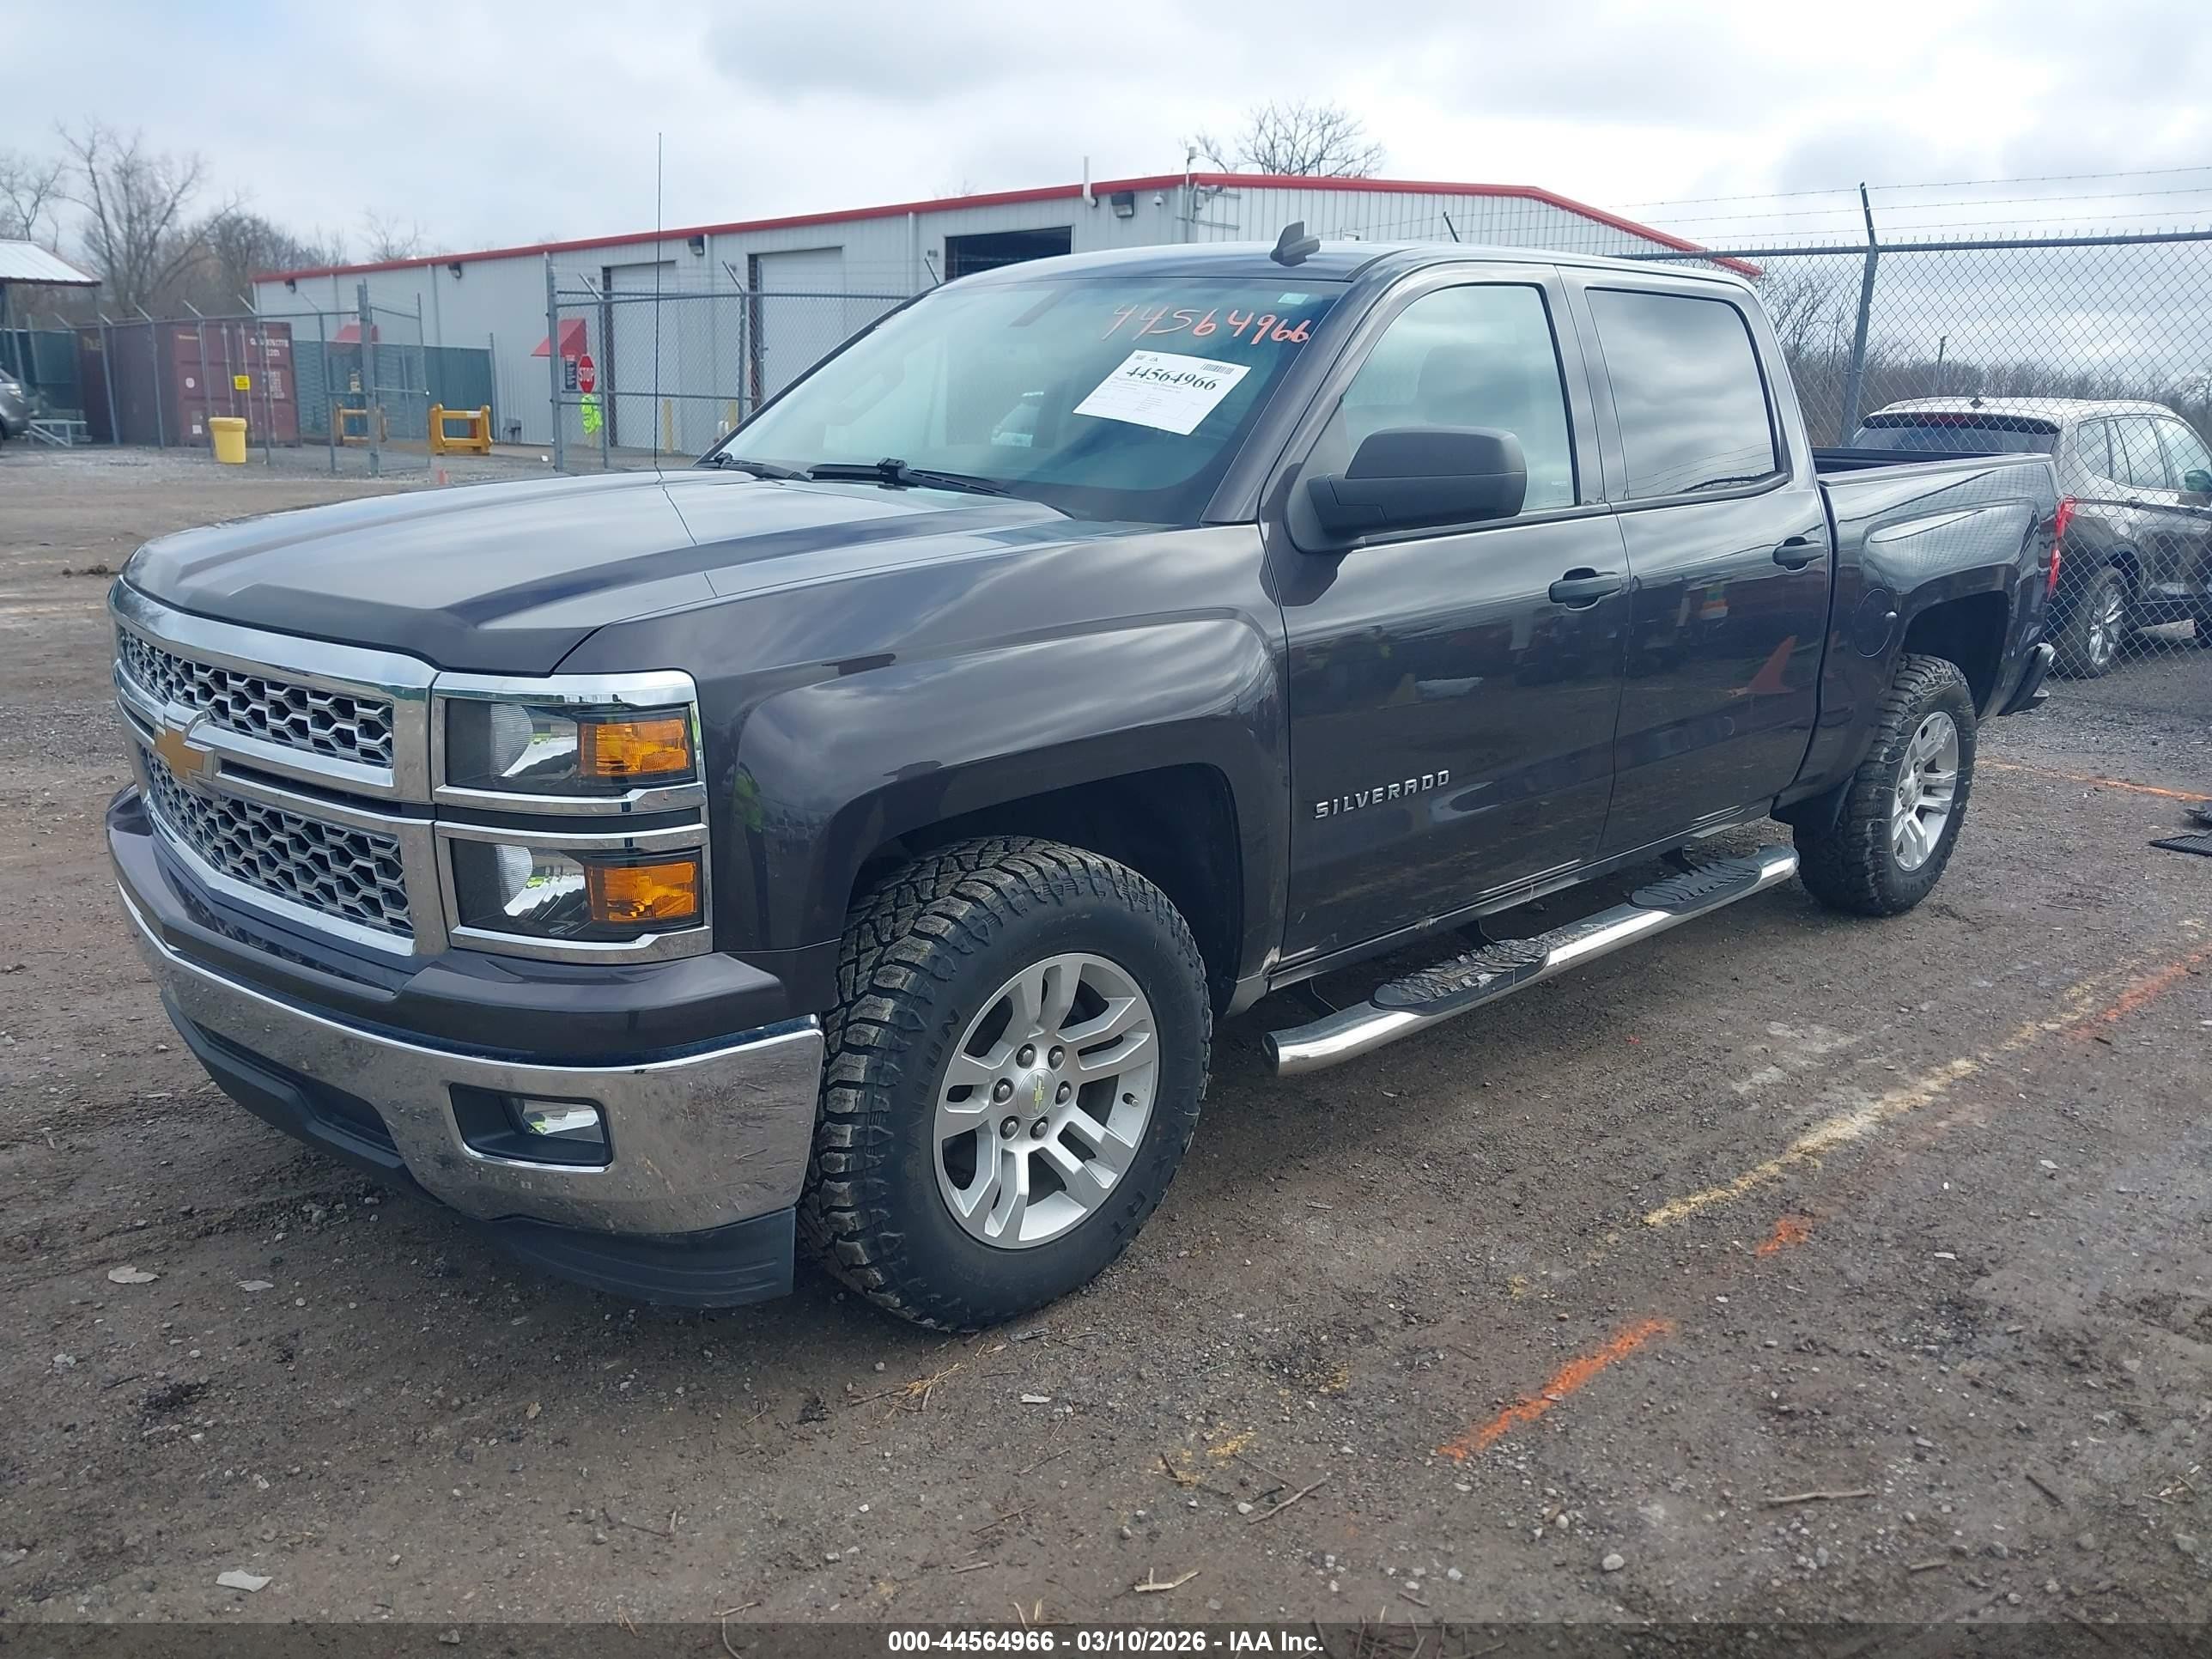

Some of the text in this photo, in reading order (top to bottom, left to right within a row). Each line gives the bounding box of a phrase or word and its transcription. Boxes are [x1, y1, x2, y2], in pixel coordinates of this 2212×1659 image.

[1102, 304, 1311, 344] 44564966
[578, 367, 595, 382] STOP
[1127, 366, 1223, 391] 44564966
[1315, 769, 1449, 819] SILVERADO
